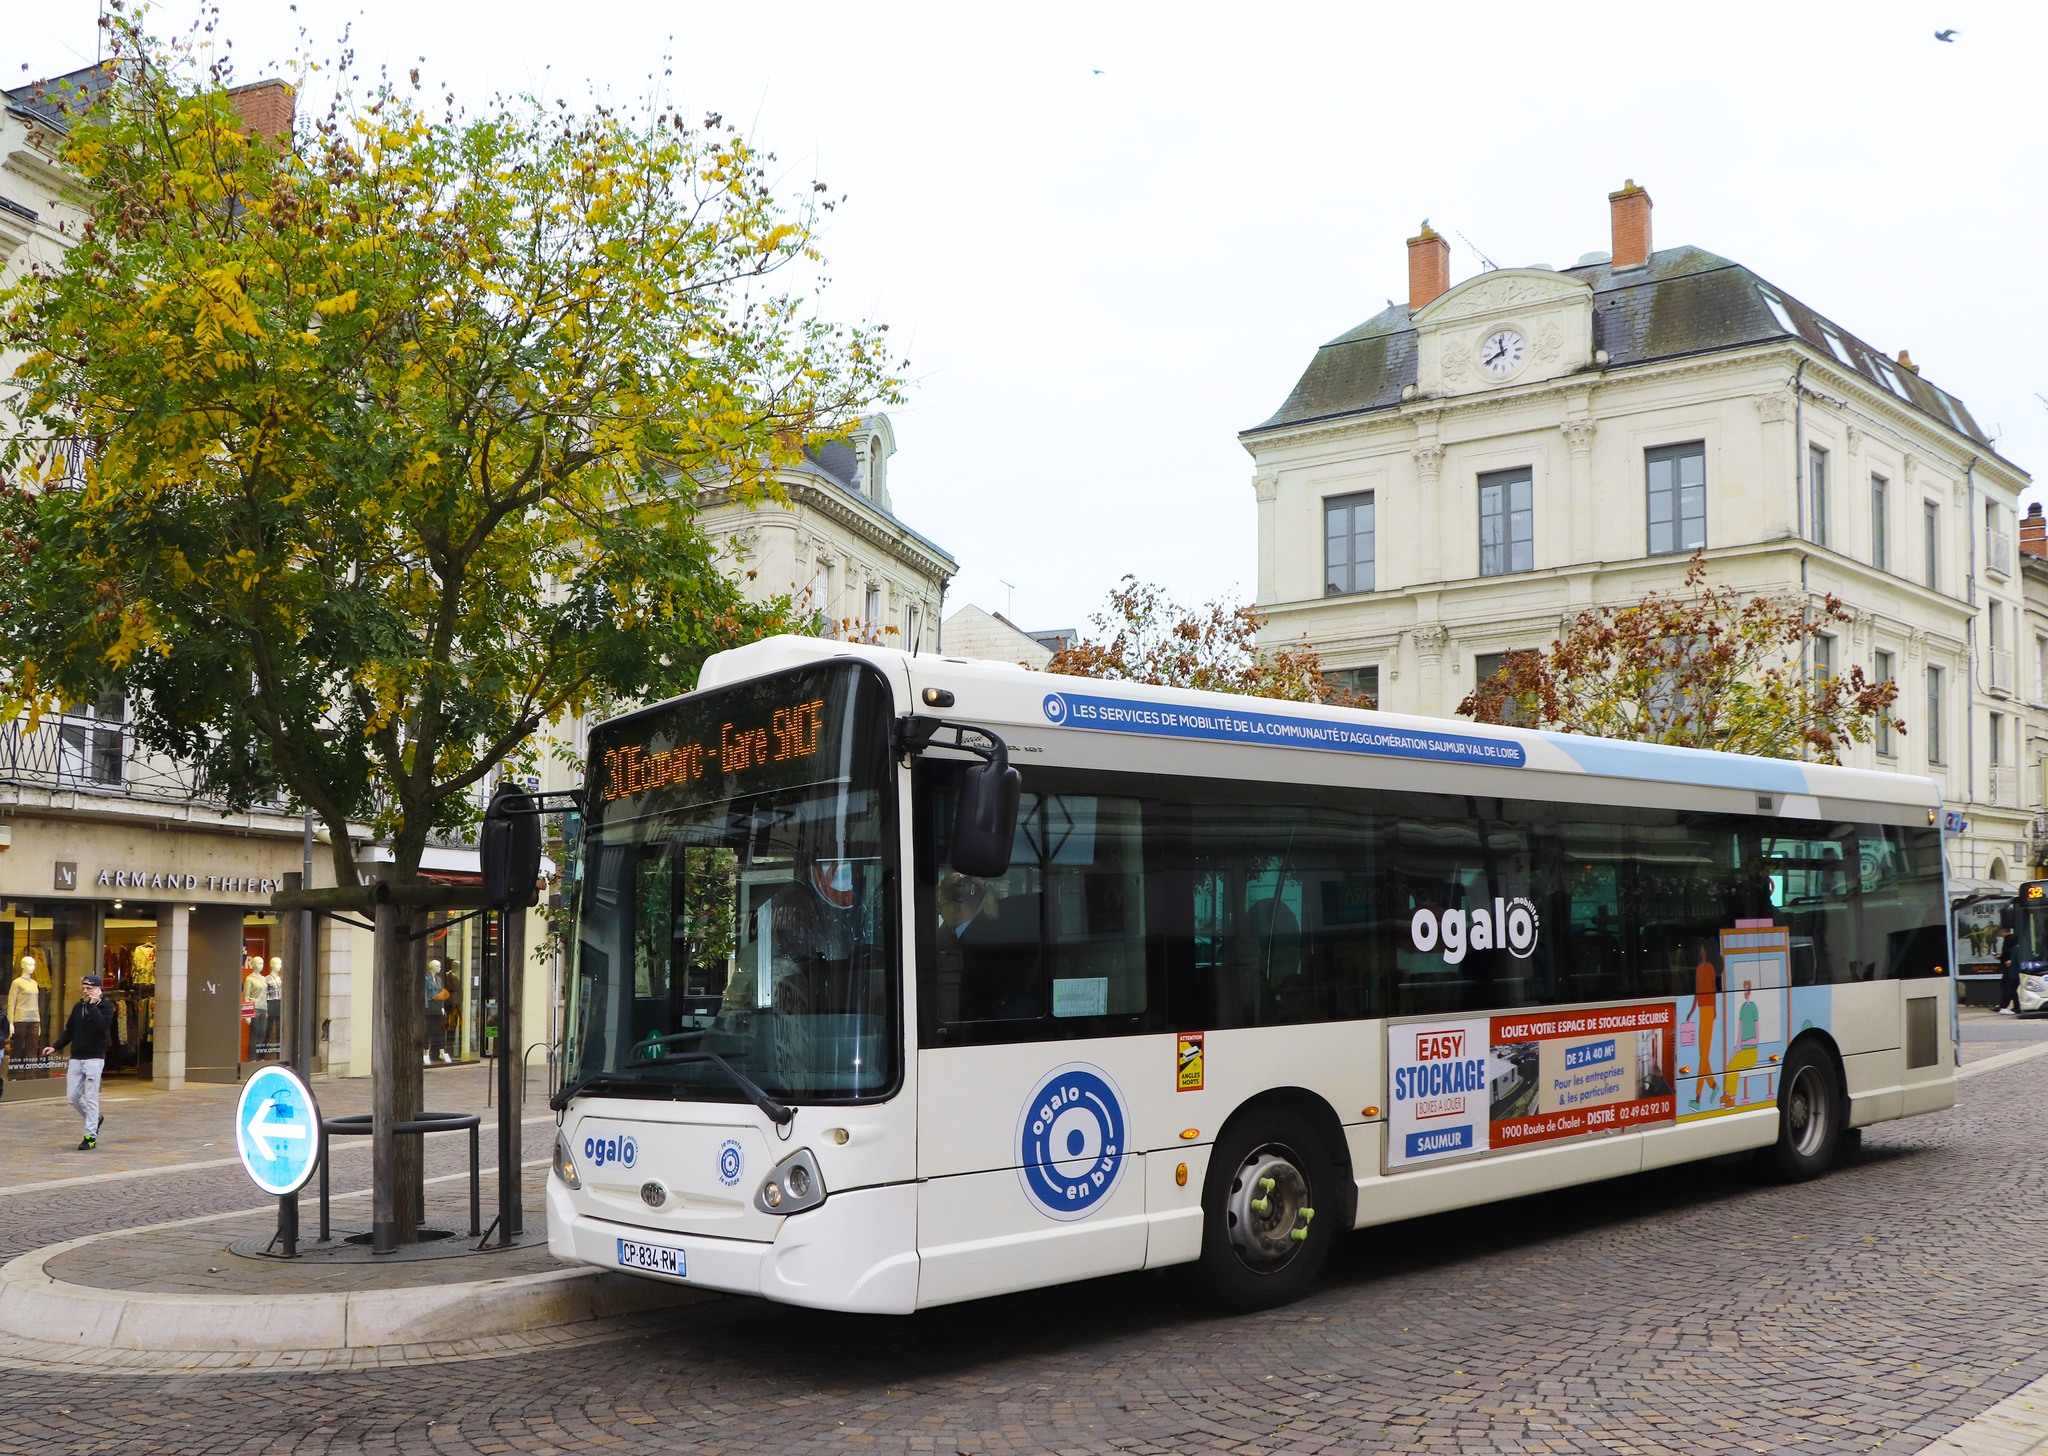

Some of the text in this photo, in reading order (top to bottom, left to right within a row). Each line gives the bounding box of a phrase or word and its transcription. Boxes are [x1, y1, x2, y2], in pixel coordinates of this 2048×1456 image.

[722, 722, 767, 771] Gare
[774, 700, 823, 760] SNCF
[1072, 704, 1097, 719] LES
[1099, 706, 1159, 725] SERVICES
[1162, 713, 1178, 727] DE
[1180, 715, 1233, 731] MOBILITÉ
[1234, 719, 1249, 733] DE
[1250, 721, 1265, 735] LA
[1266, 723, 1340, 742] COMMUNAUTÉ
[1428, 739, 1466, 754] SAUMUR
[1466, 743, 1484, 756] VAL
[1484, 746, 1496, 757] DE
[1497, 747, 1520, 760] LOIRE
[98, 869, 282, 894] ARMAND THIERY
[2028, 886, 2044, 899] 32
[1411, 897, 1533, 965] ogalo
[1501, 1009, 1669, 1039] LOUEZ VOTRE ESPACE DE STOCKAGE SÉCURISÉ
[1419, 1036, 1463, 1062] EASY
[1567, 1053, 1577, 1066] DE
[1578, 1051, 1584, 1063] 2
[1585, 1047, 1592, 1062] À
[1593, 1047, 1603, 1060] 40
[1395, 1059, 1485, 1101] STOCKAGE
[1554, 1066, 1625, 1091] Pour les entreprises
[1559, 1083, 1620, 1105] & les particuliers
[1032, 1086, 1080, 1136] ogalo
[1502, 1125, 1522, 1139] 1900
[1523, 1122, 1545, 1136] Route
[1546, 1119, 1556, 1132] de
[1557, 1116, 1580, 1130] Cholet
[1587, 1105, 1615, 1125] DISTRÉ
[1620, 1107, 1630, 1119] 02
[1631, 1106, 1640, 1118] 49
[1640, 1104, 1650, 1116] 62
[1650, 1102, 1660, 1114] 92
[1661, 1101, 1670, 1113] 10
[584, 1135, 635, 1167] ogalo
[1417, 1132, 1462, 1152] SAUMUR
[1066, 1144, 1117, 1200] en bus
[623, 1243, 677, 1271] CP-834-RW
